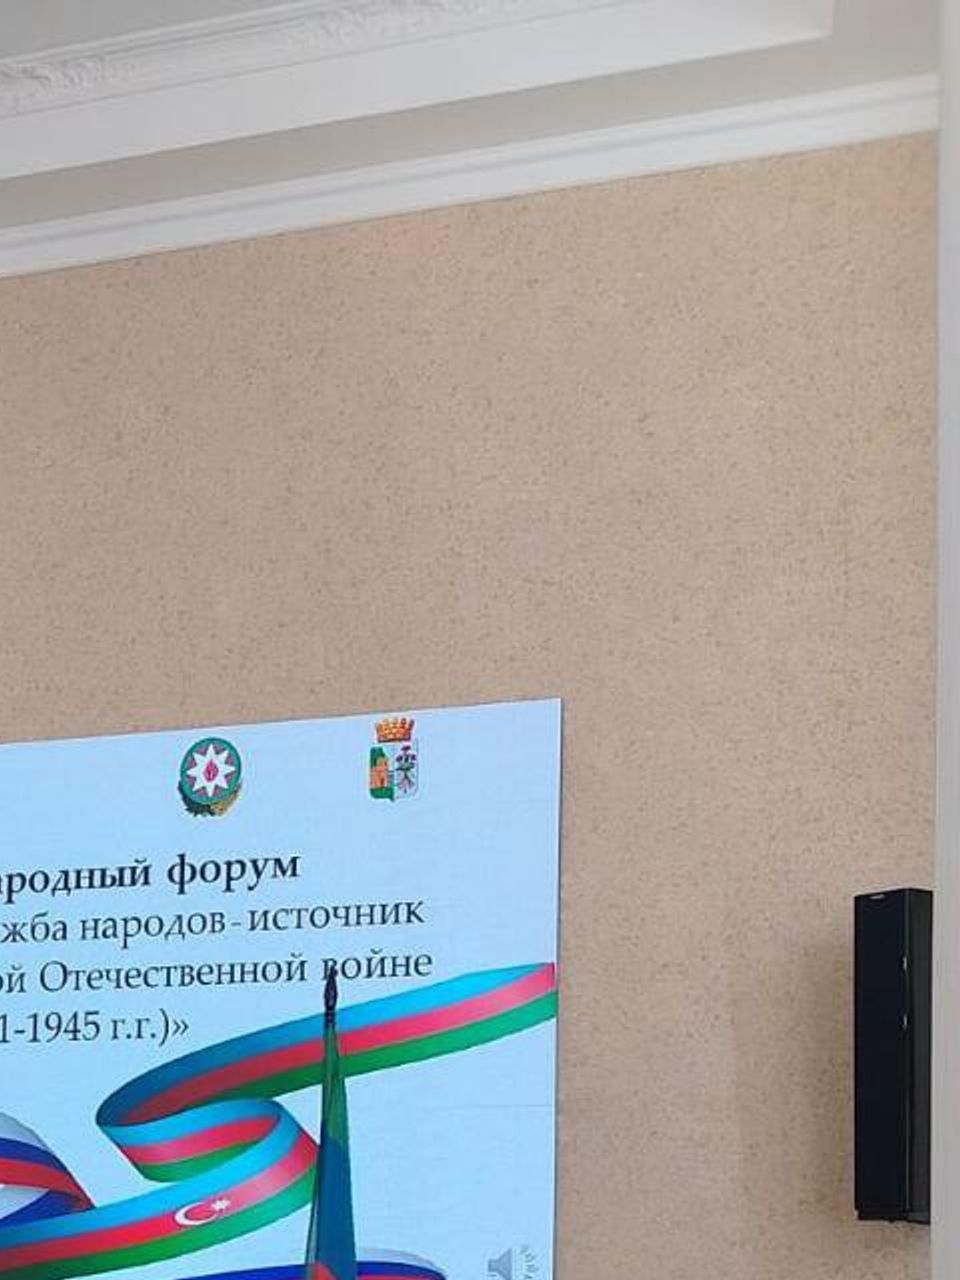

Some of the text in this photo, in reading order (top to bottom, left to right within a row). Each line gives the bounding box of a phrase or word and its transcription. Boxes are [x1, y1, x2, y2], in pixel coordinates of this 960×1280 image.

[167, 852, 300, 894] форум
[39, 953, 308, 994] Отечественной
[110, 1006, 190, 1048] г.г.)»
